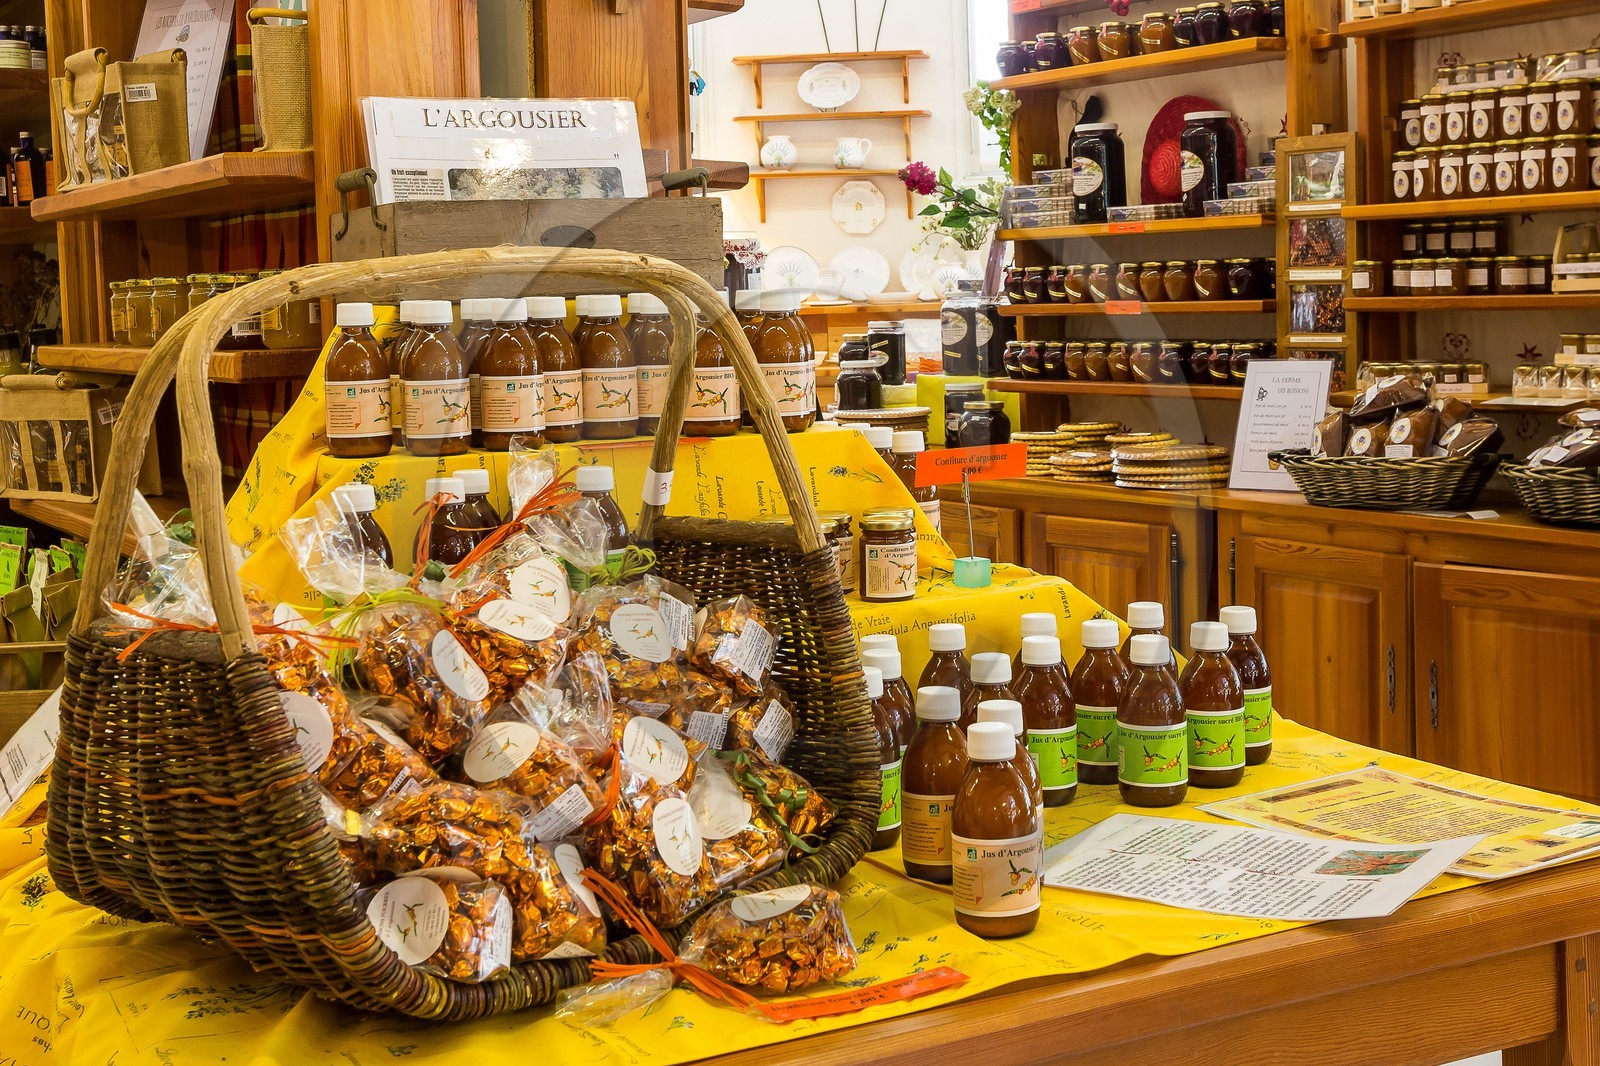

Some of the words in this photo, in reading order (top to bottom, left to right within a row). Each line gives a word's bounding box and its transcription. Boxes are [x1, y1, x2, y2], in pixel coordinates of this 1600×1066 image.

[422, 107, 587, 130] L'ARGOUSIER
[584, 374, 594, 382] Jus
[433, 386, 466, 395] d'Argousier
[518, 382, 529, 390] Jus
[359, 387, 370, 395] Jus
[935, 456, 968, 467] Confiture
[969, 453, 1008, 464] d'argousier
[961, 466, 977, 476] 500
[977, 465, 983, 474] €
[864, 614, 891, 628] Vraie
[1093, 712, 1111, 721] sucré
[1217, 717, 1234, 726] sucré
[1031, 735, 1043, 744] Jus
[1127, 731, 1167, 741] d'Argousier
[1167, 731, 1183, 740] sucré
[981, 850, 996, 859] Jus
[997, 844, 1038, 858] d'Argousier
[878, 993, 886, 1001] €
